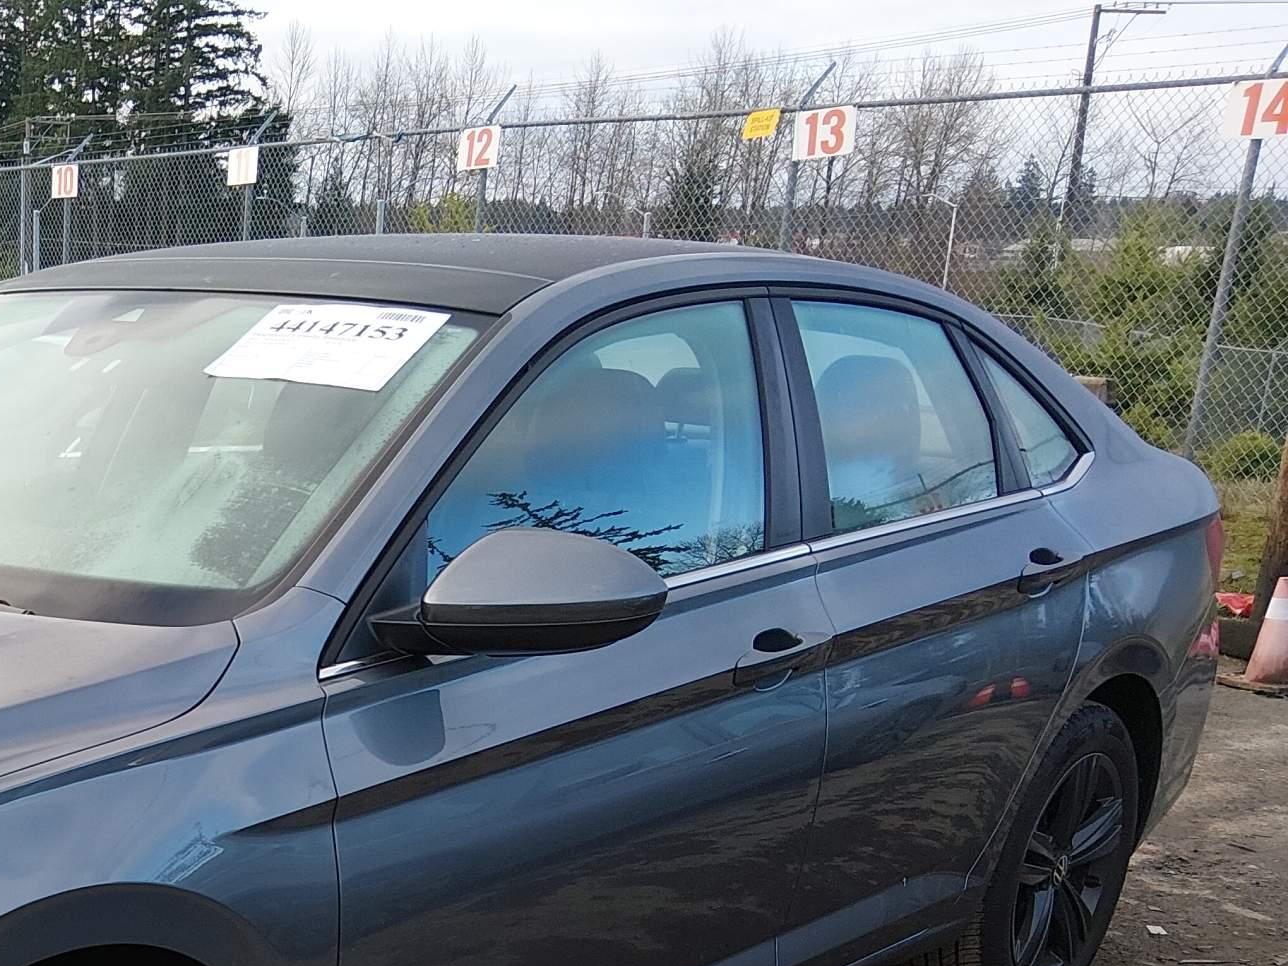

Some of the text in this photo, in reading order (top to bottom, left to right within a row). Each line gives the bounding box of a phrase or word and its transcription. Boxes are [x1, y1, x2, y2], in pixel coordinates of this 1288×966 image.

[1240, 81, 1288, 136] 14
[466, 128, 493, 168] 12
[805, 109, 847, 157] 13
[56, 166, 74, 196] 10
[270, 319, 409, 341] 44147153
